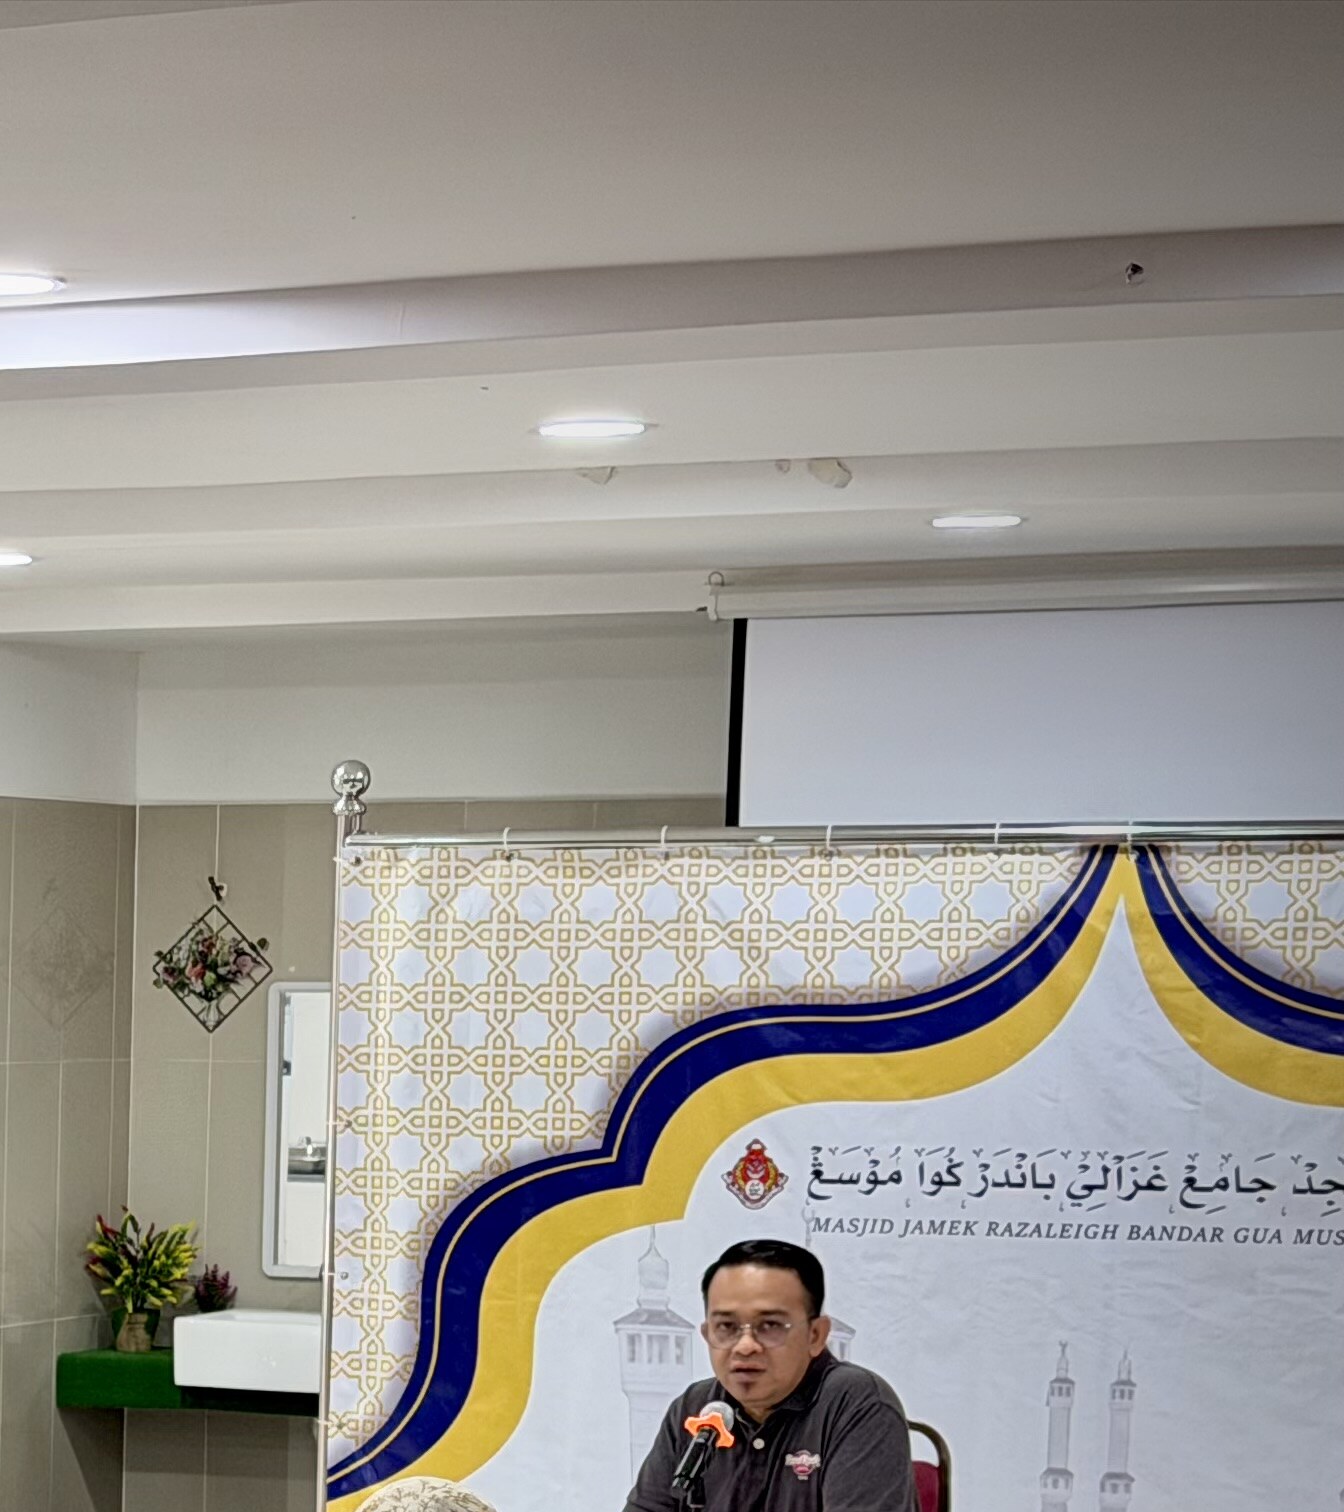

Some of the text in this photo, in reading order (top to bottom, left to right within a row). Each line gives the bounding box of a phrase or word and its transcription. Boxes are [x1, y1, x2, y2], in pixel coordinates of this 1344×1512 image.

[812, 1217, 895, 1238] MASJID
[898, 1219, 979, 1238] JAMEK
[985, 1220, 1120, 1241] RAZALEIGH
[1127, 1225, 1225, 1243] BANDAR
[1233, 1228, 1283, 1245] GUA
